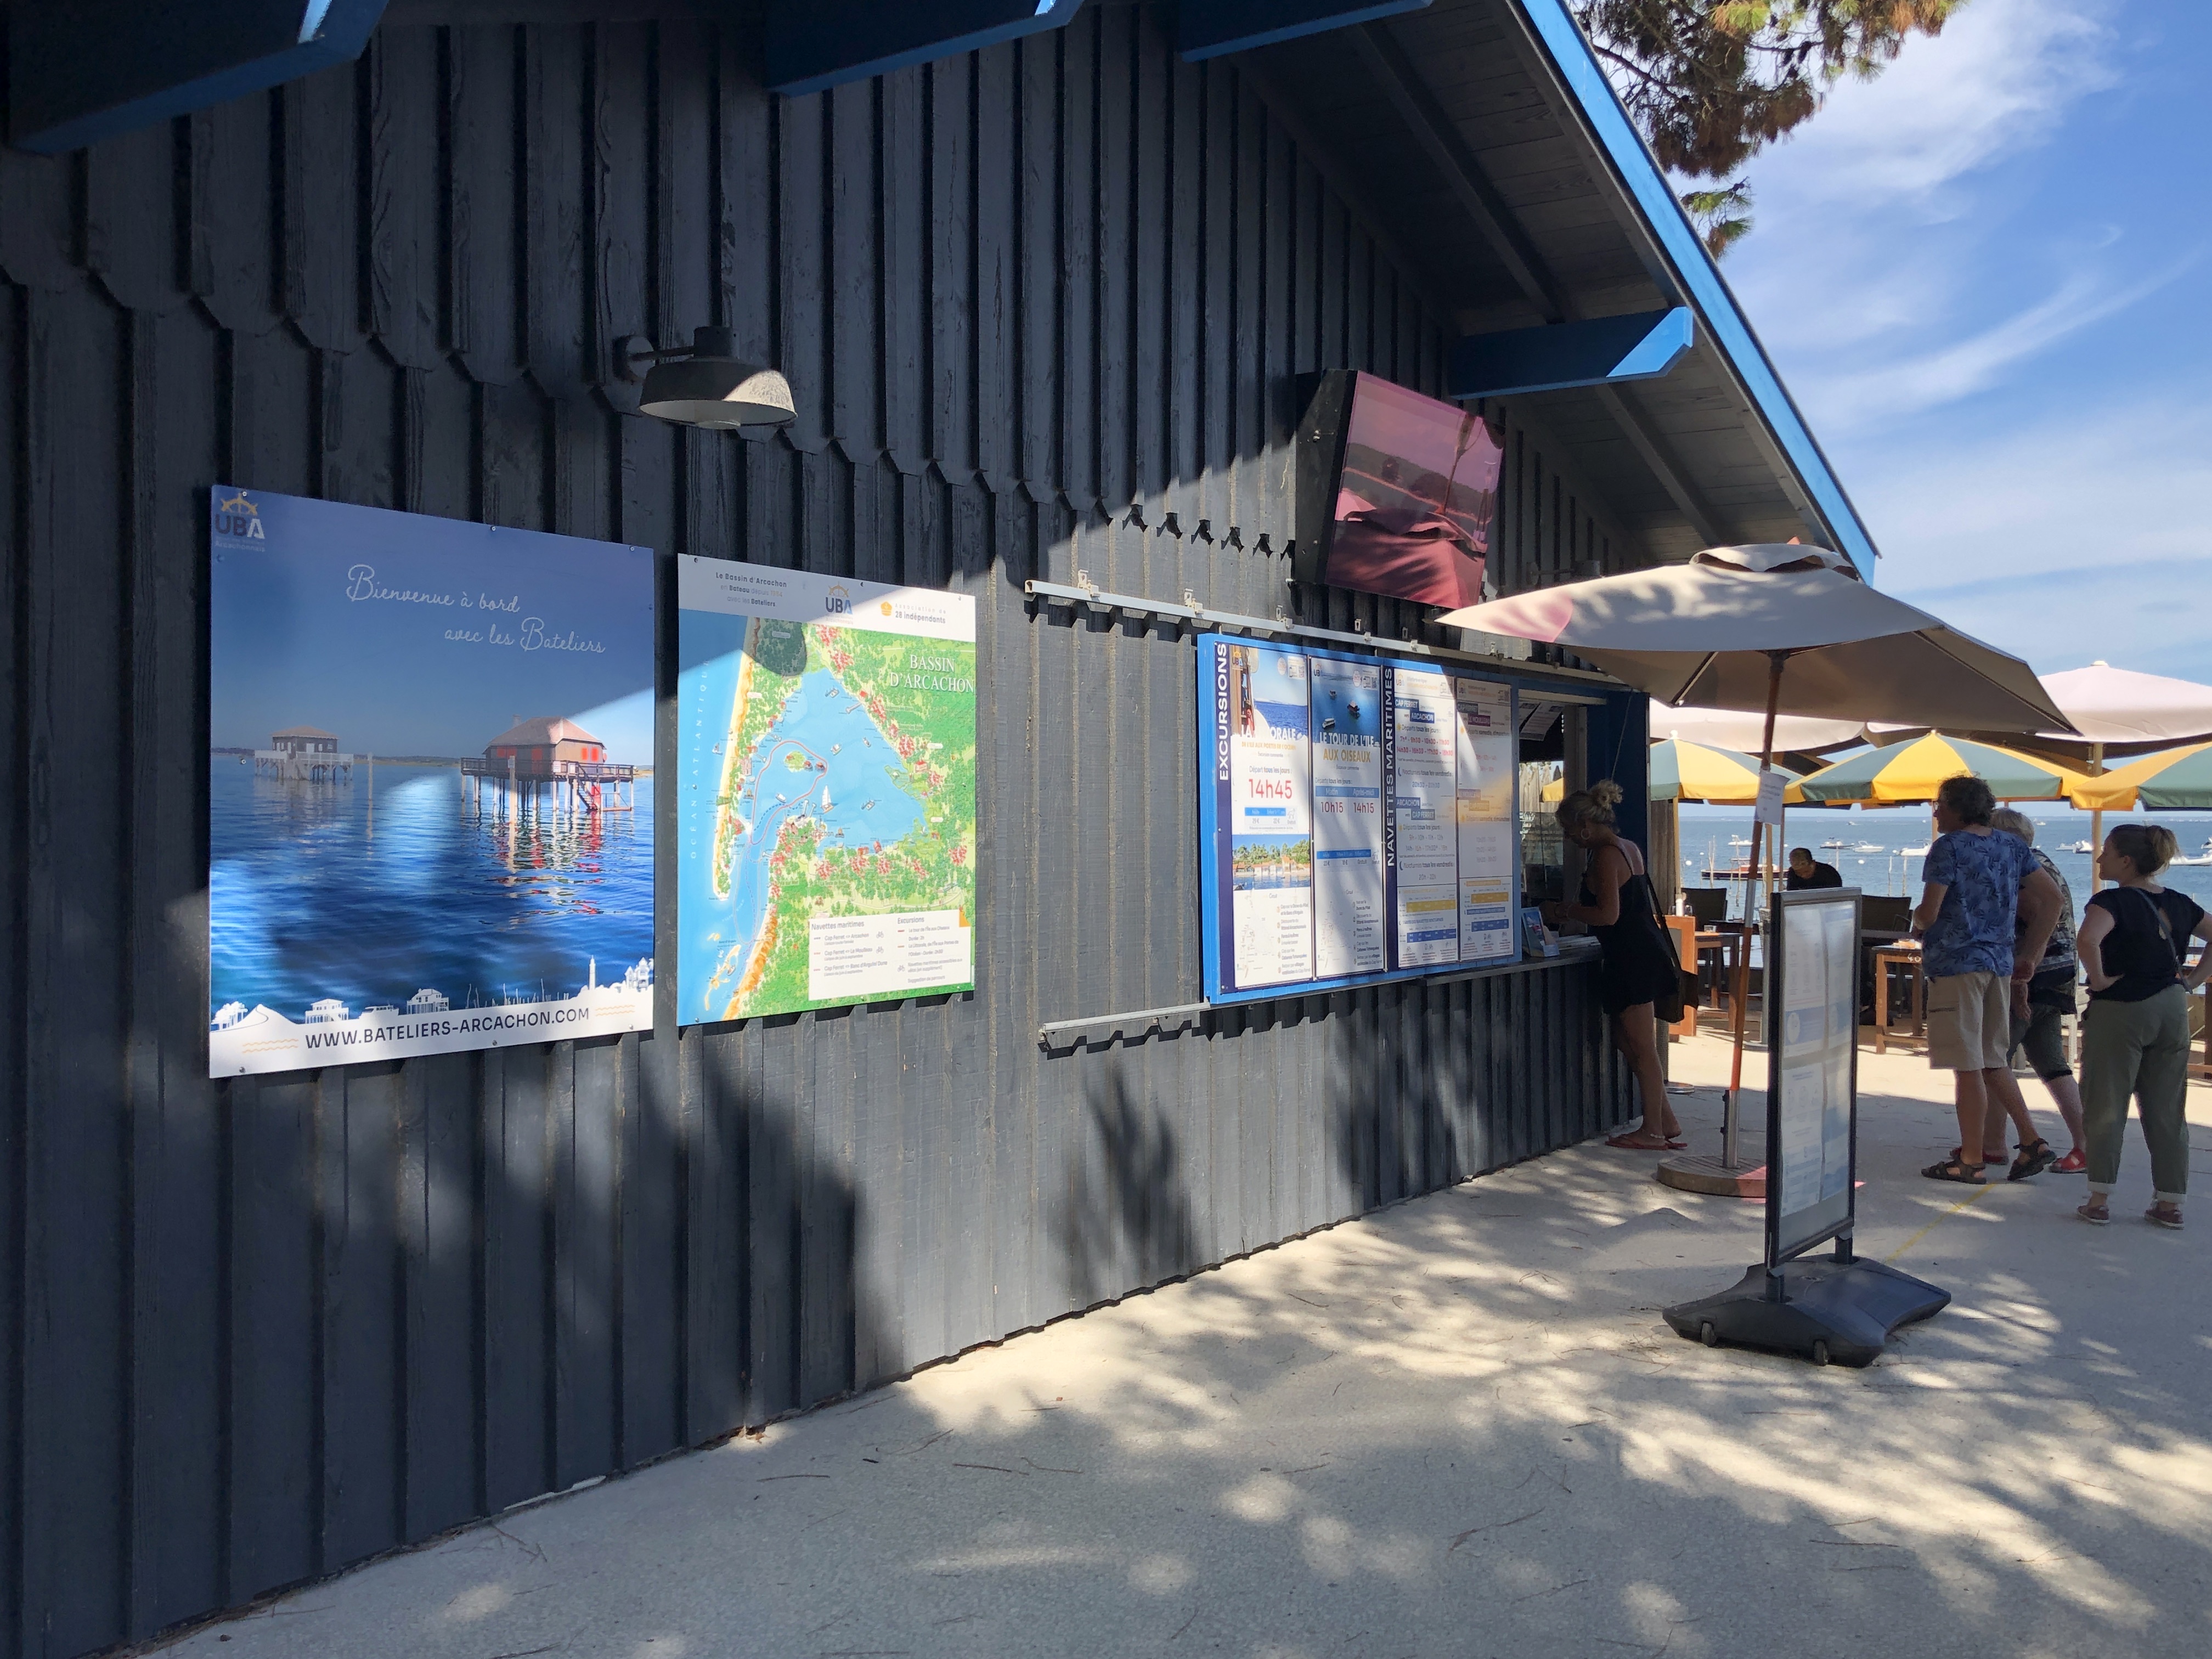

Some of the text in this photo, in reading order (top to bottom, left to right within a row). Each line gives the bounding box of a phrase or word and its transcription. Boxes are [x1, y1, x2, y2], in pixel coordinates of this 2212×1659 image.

[215, 514, 266, 539] UBA
[725, 573, 748, 582] Bassin
[346, 563, 521, 613] Bienvenue à bord
[729, 585, 750, 593] Bateau
[751, 598, 776, 607] Bateliers
[825, 596, 853, 615] UBA
[904, 611, 946, 624] indépendants
[444, 617, 606, 653] avec les Bateliers
[910, 654, 956, 673] BASSIN
[1232, 657, 1244, 667] UBA
[890, 672, 975, 693] D'ARCACHON
[1217, 642, 1229, 781] EXCURSIONS
[1319, 731, 1327, 744] LE
[1329, 732, 1348, 746] TOUR
[1350, 734, 1358, 746] DE
[1323, 748, 1371, 763] AUX OISEAUX
[1249, 766, 1263, 774] Départ
[1385, 668, 1395, 867] NAVETTES MARITIMES
[1249, 778, 1293, 799] 14h45
[1321, 802, 1375, 814] 10h15 14h15
[305, 1007, 590, 1049] WWW.BATELIERS-ARCACHON.COM
